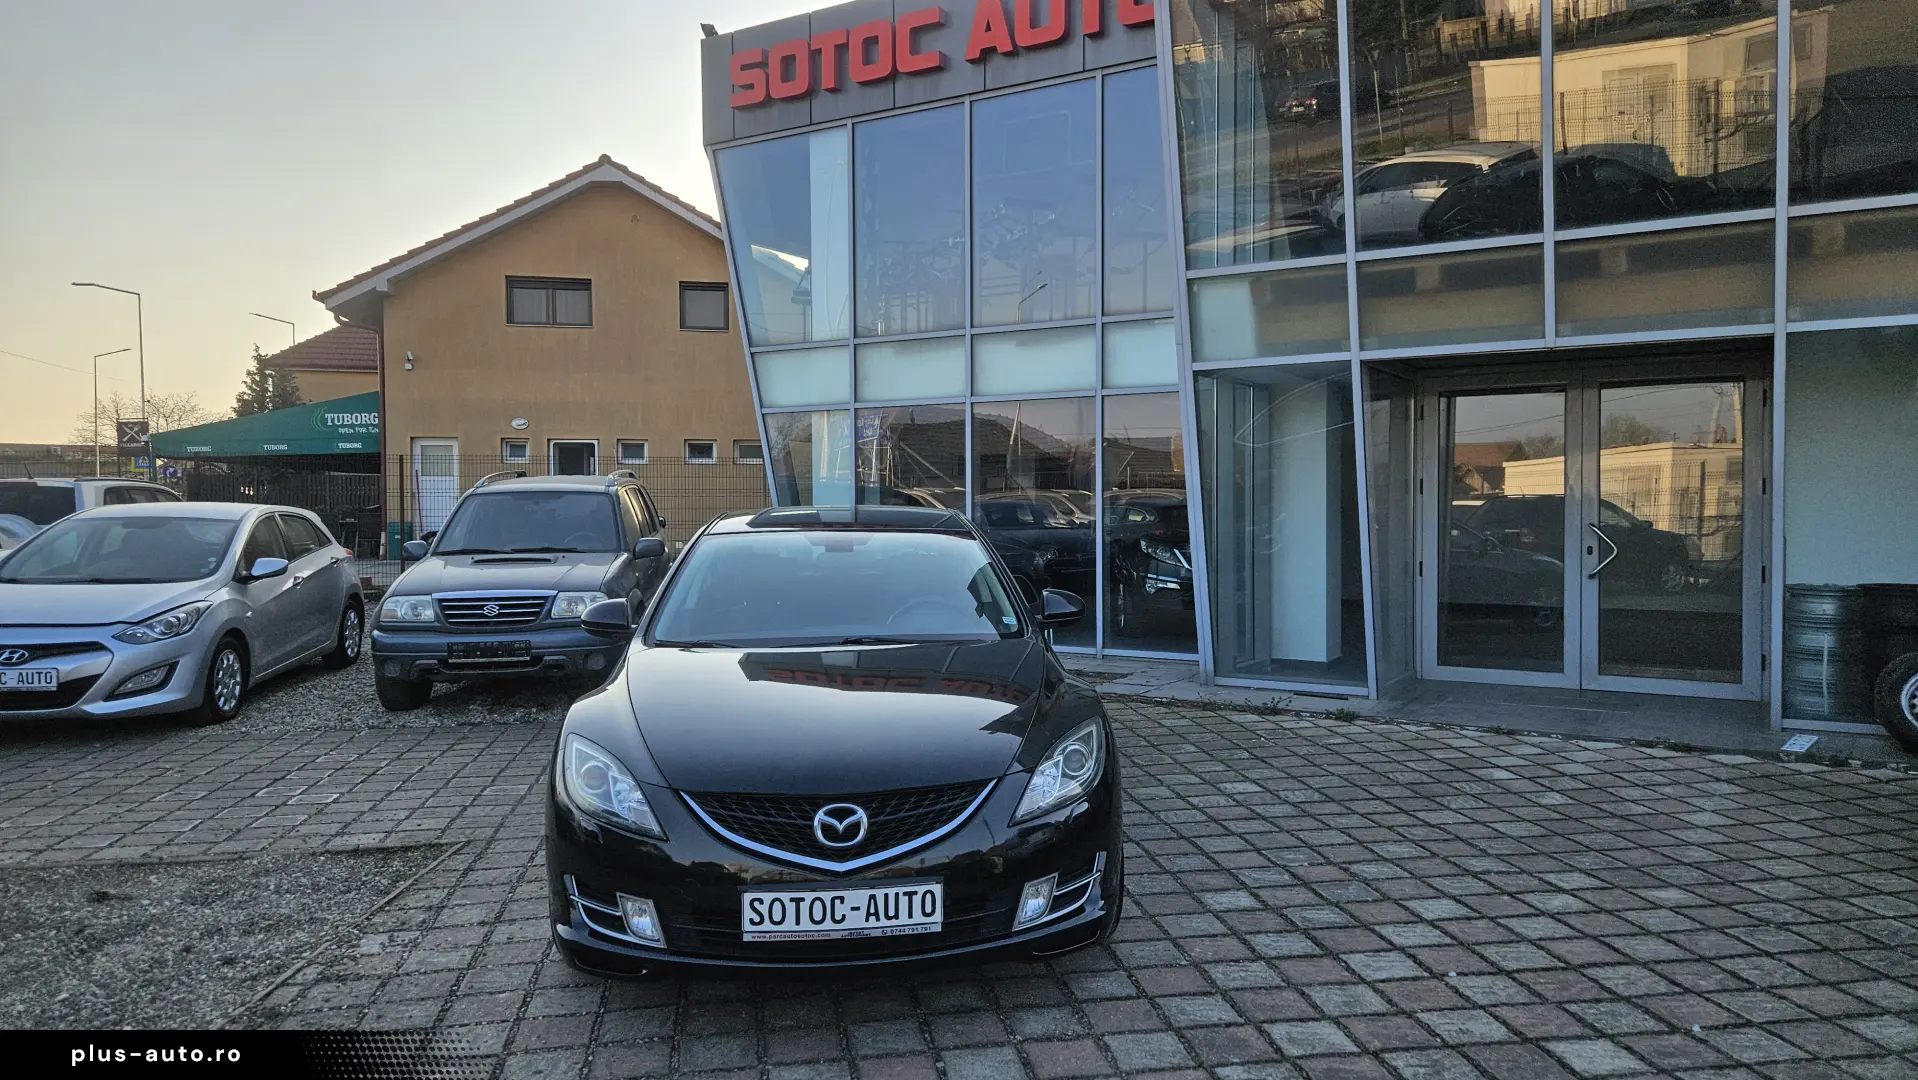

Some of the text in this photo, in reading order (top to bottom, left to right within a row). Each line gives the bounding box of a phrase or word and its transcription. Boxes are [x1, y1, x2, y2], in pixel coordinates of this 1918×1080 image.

[729, 6, 945, 109] SOTOC
[325, 412, 379, 426] TUBORG
[187, 445, 212, 453] TUBORG
[748, 888, 937, 927] SOTOC-AUTO
